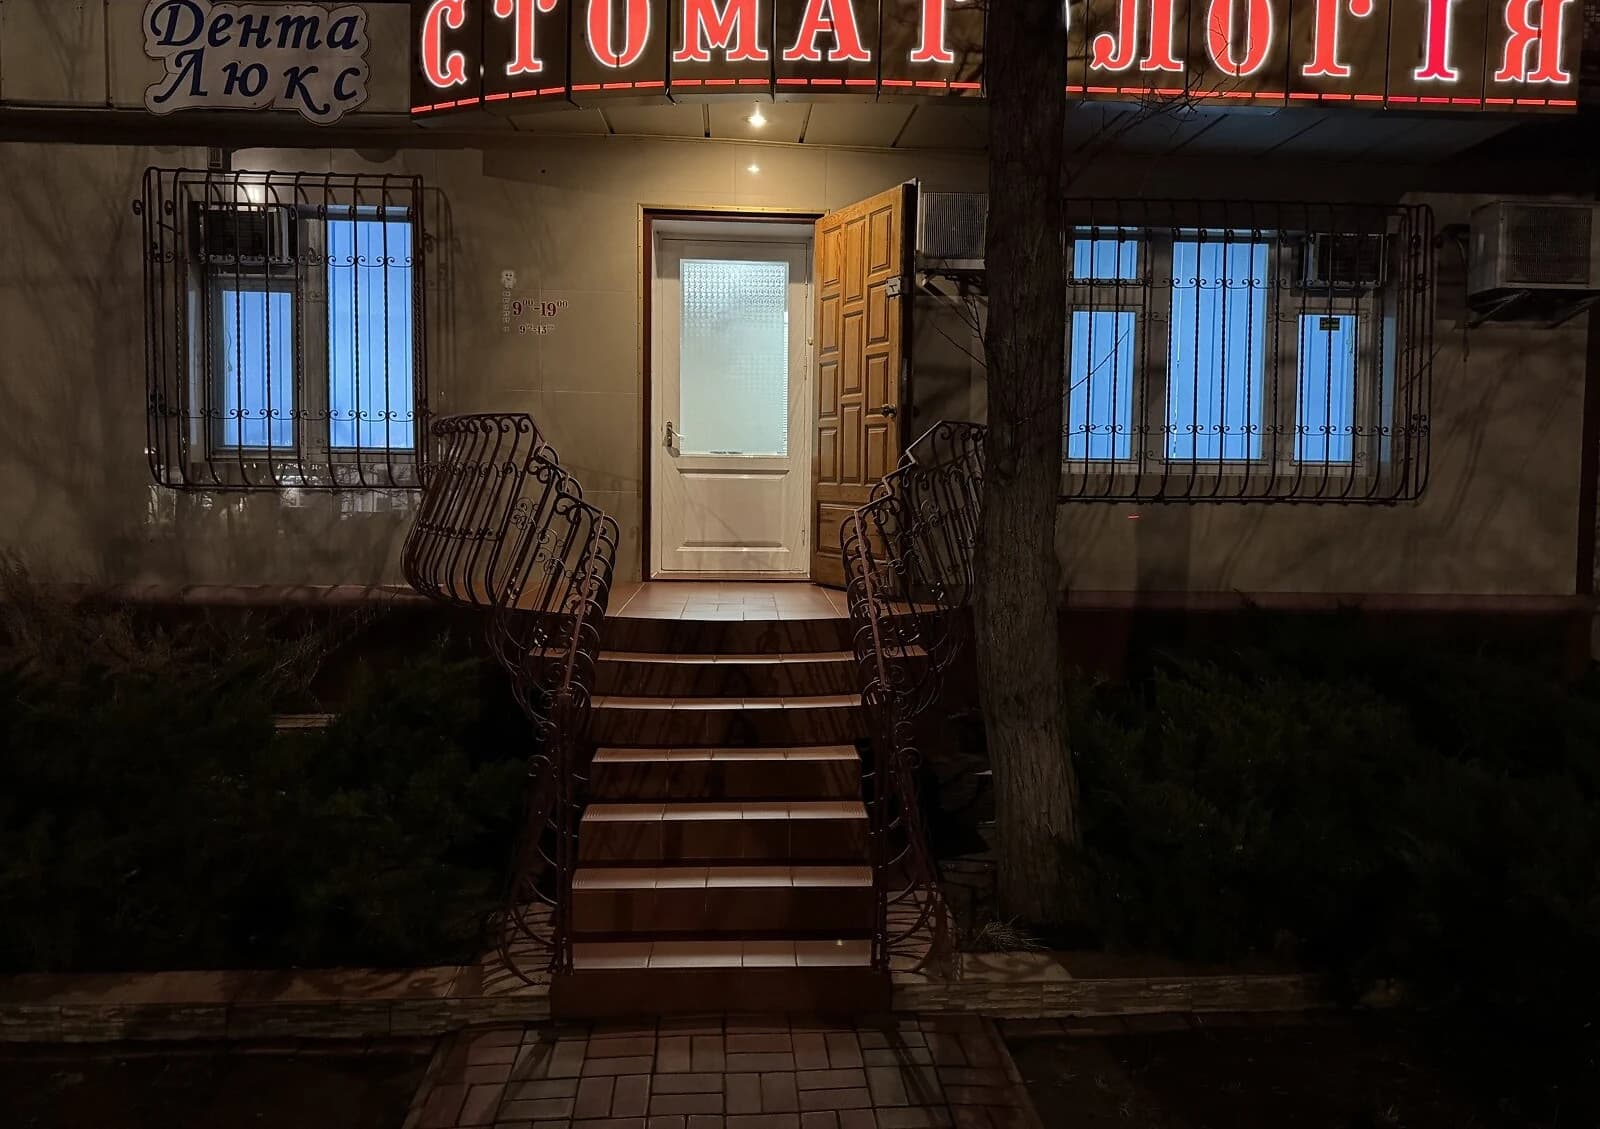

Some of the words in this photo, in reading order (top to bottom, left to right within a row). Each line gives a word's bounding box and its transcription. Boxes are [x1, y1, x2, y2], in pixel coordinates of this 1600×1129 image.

[151, 1, 359, 49] Дента
[421, 0, 1573, 88] СТОМАТЛОГІЯ
[153, 46, 361, 115] Люкс
